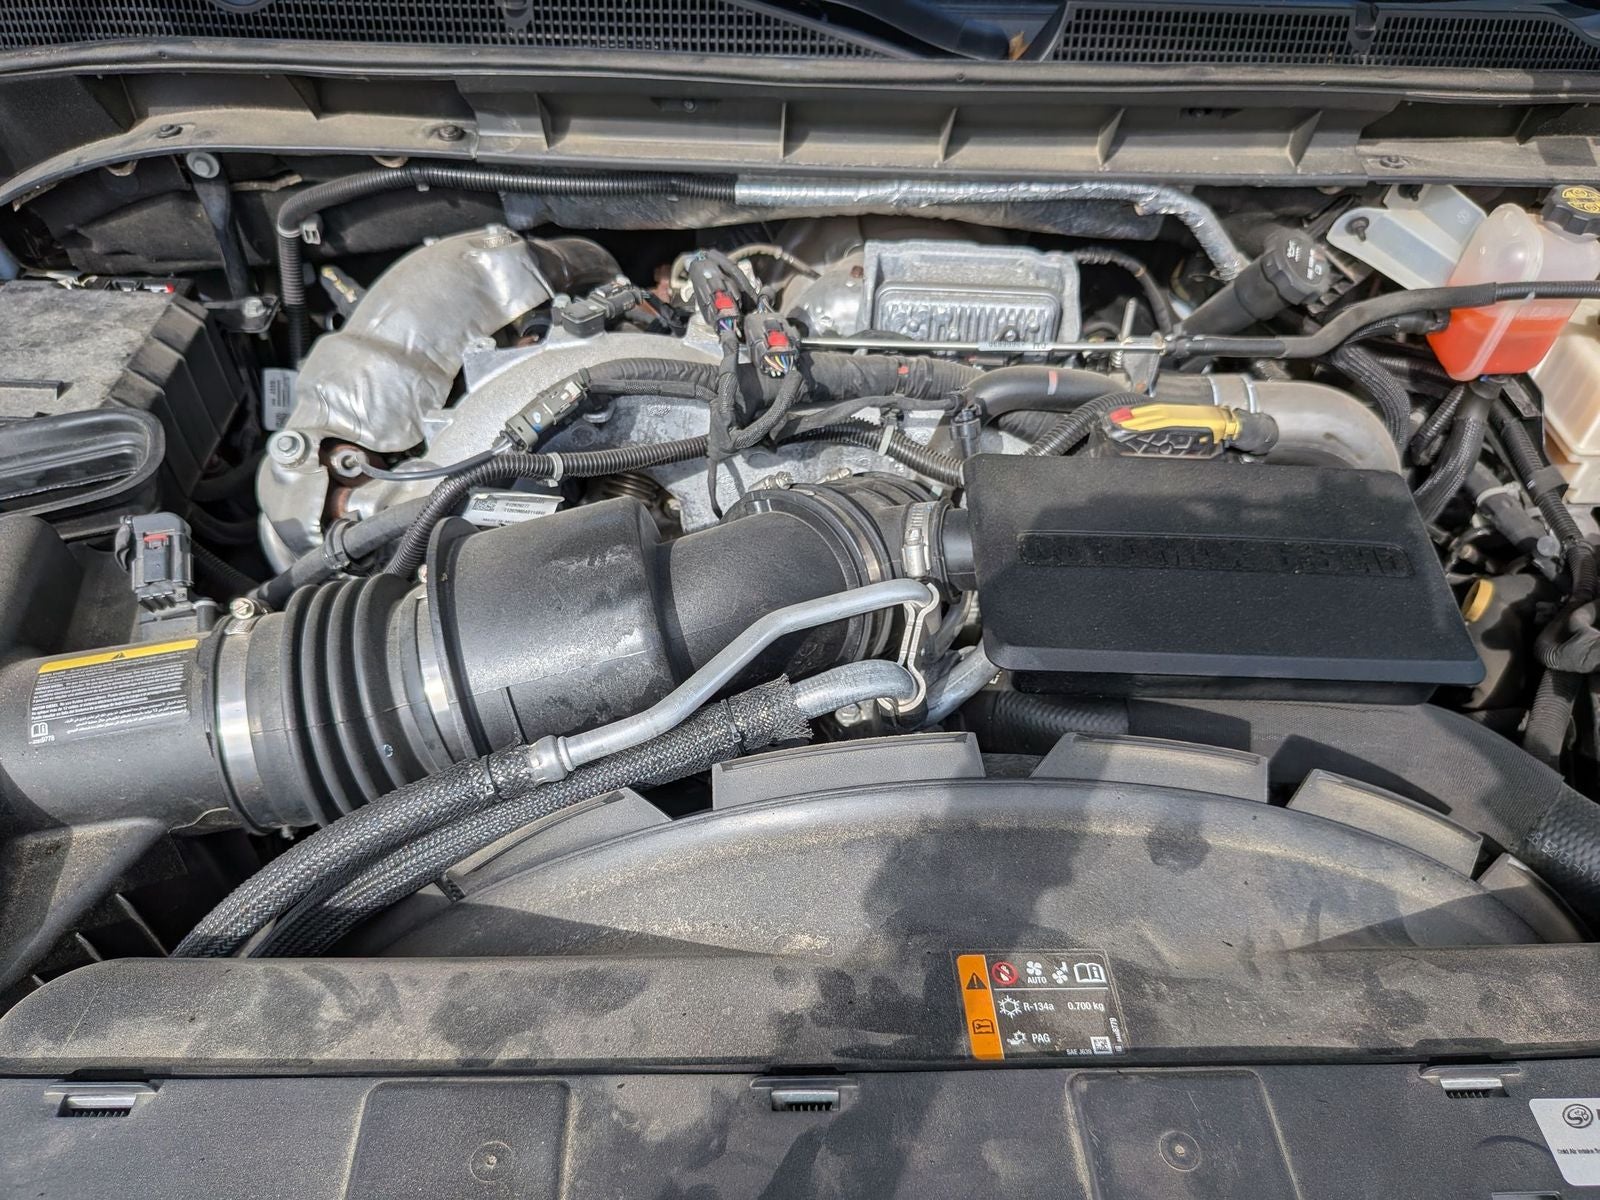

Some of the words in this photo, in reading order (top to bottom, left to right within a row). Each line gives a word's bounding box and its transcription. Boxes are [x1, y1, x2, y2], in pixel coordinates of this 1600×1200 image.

[1027, 976, 1047, 984] AUTO
[1023, 1002, 1054, 1012] R-134a
[1067, 1002, 1092, 1010] 0.700
[1092, 1002, 1105, 1012] kg
[1031, 1033, 1050, 1043] PAG
